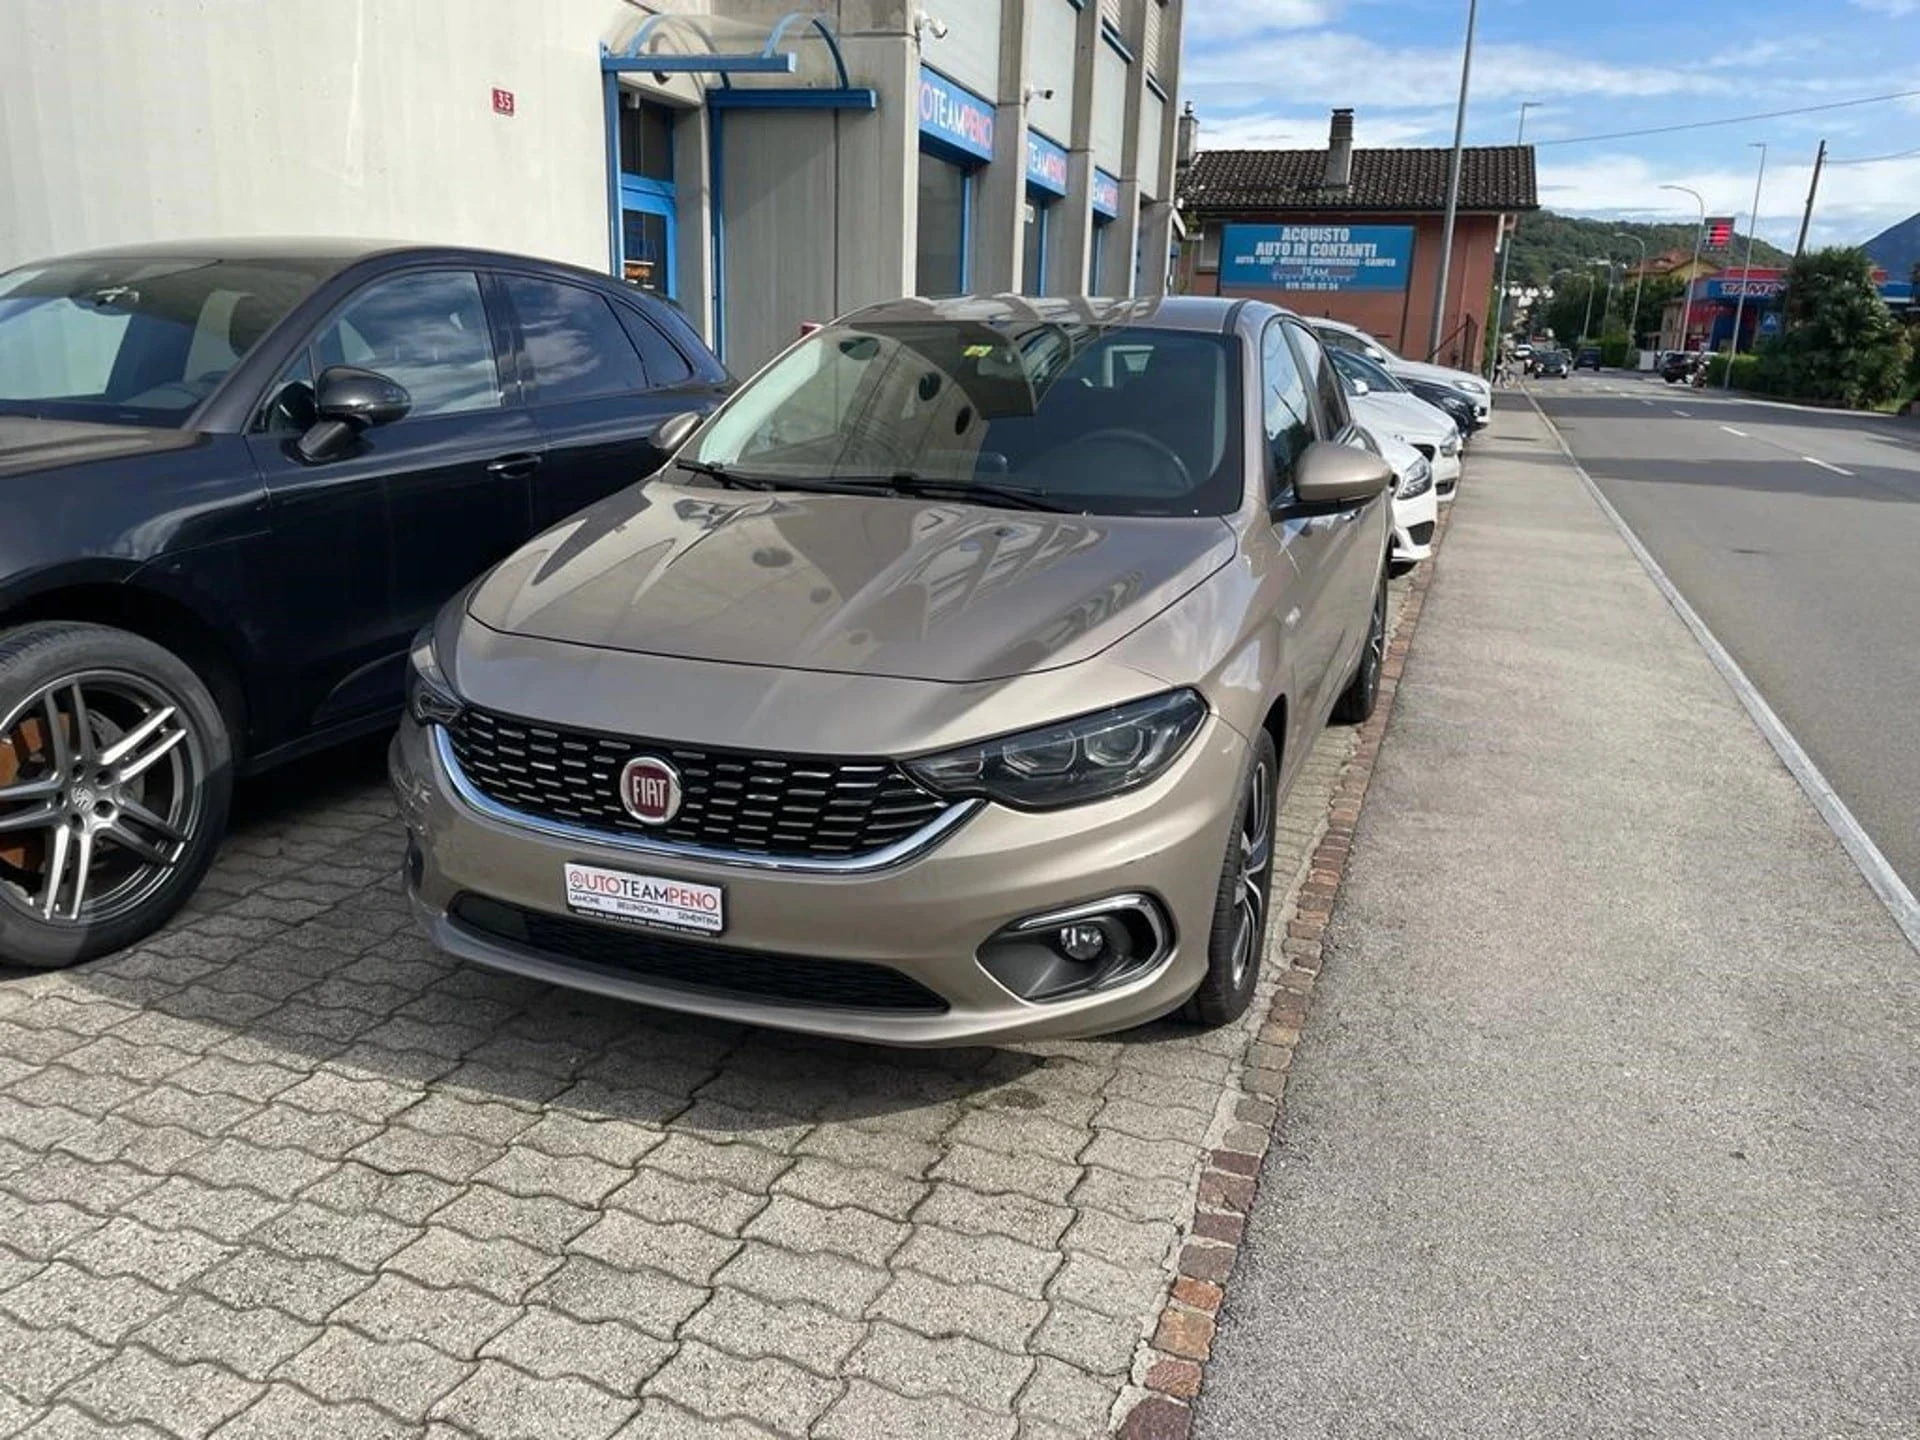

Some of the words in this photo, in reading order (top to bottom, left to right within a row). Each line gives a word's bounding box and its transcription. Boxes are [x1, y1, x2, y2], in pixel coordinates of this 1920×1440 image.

[497, 91, 511, 109] 35
[919, 83, 993, 149] OTEAMPENO
[1281, 227, 1350, 243] ACQUISTO
[1255, 241, 1291, 256] AUTO
[1293, 242, 1308, 256] IN
[1310, 242, 1377, 257] CONTANTI
[632, 775, 667, 808] FIAT
